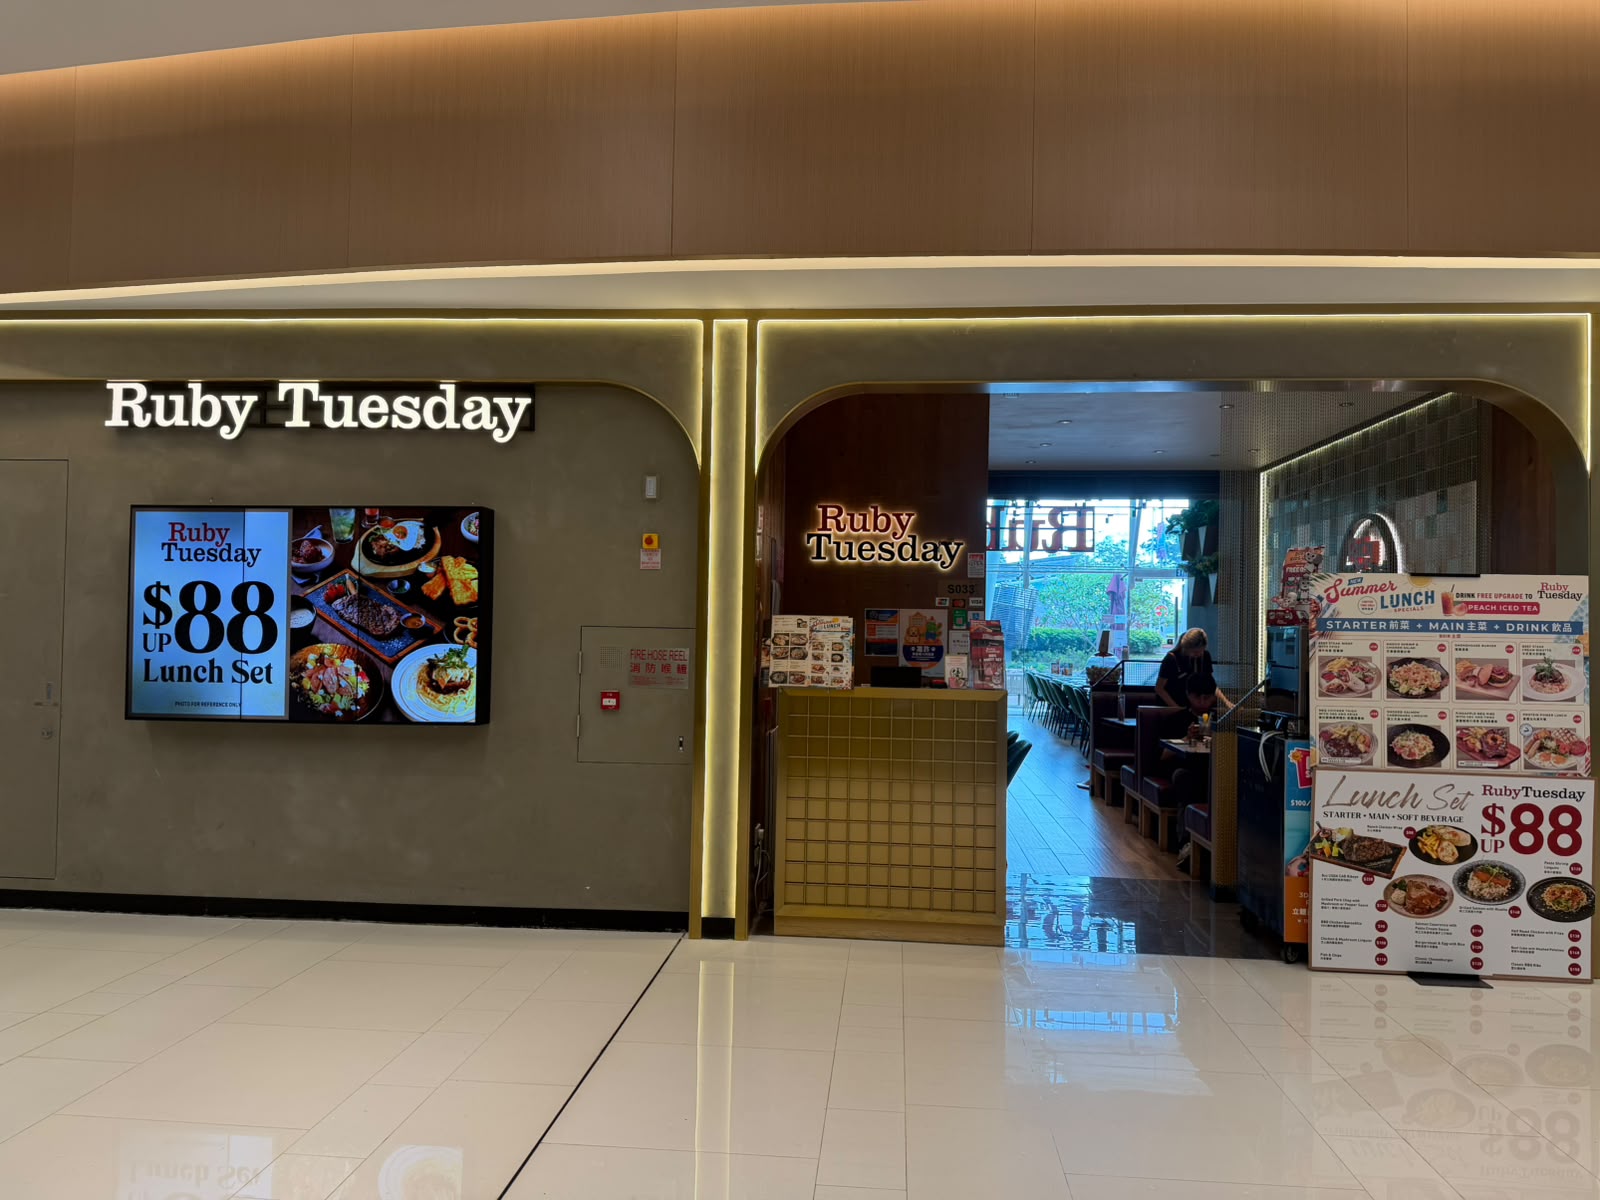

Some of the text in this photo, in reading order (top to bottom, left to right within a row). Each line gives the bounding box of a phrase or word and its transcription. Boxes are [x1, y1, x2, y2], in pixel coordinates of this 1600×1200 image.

[105, 382, 531, 443] Ruby Tuesday
[817, 504, 915, 540] Ruby
[168, 522, 230, 547] Ruby
[161, 542, 262, 568] Tuesday
[806, 533, 963, 570] Tuesday
[947, 584, 976, 595] S033
[1324, 578, 1397, 604] Summer
[1537, 590, 1582, 602] Tuesday
[1540, 582, 1569, 593] Ruby
[1380, 590, 1435, 611] LUNCH
[1499, 604, 1520, 612] ICED
[142, 580, 278, 655] $88
[1326, 620, 1388, 630] STARTER
[1389, 620, 1410, 631] 前菜
[1429, 622, 1464, 632] MAIN
[1467, 621, 1488, 632] 主菜
[1506, 623, 1549, 633] DRINK
[1551, 622, 1573, 633] 飲品
[142, 632, 172, 653] UP
[630, 649, 688, 662] FIRE HOSE REEL
[143, 659, 273, 684] Lunch Set
[1322, 775, 1474, 812] Lunch Set
[1323, 810, 1464, 824] STARTER MAIN SOFT BEVERAGE
[1480, 802, 1583, 857] $88
[1480, 838, 1505, 854] UP
